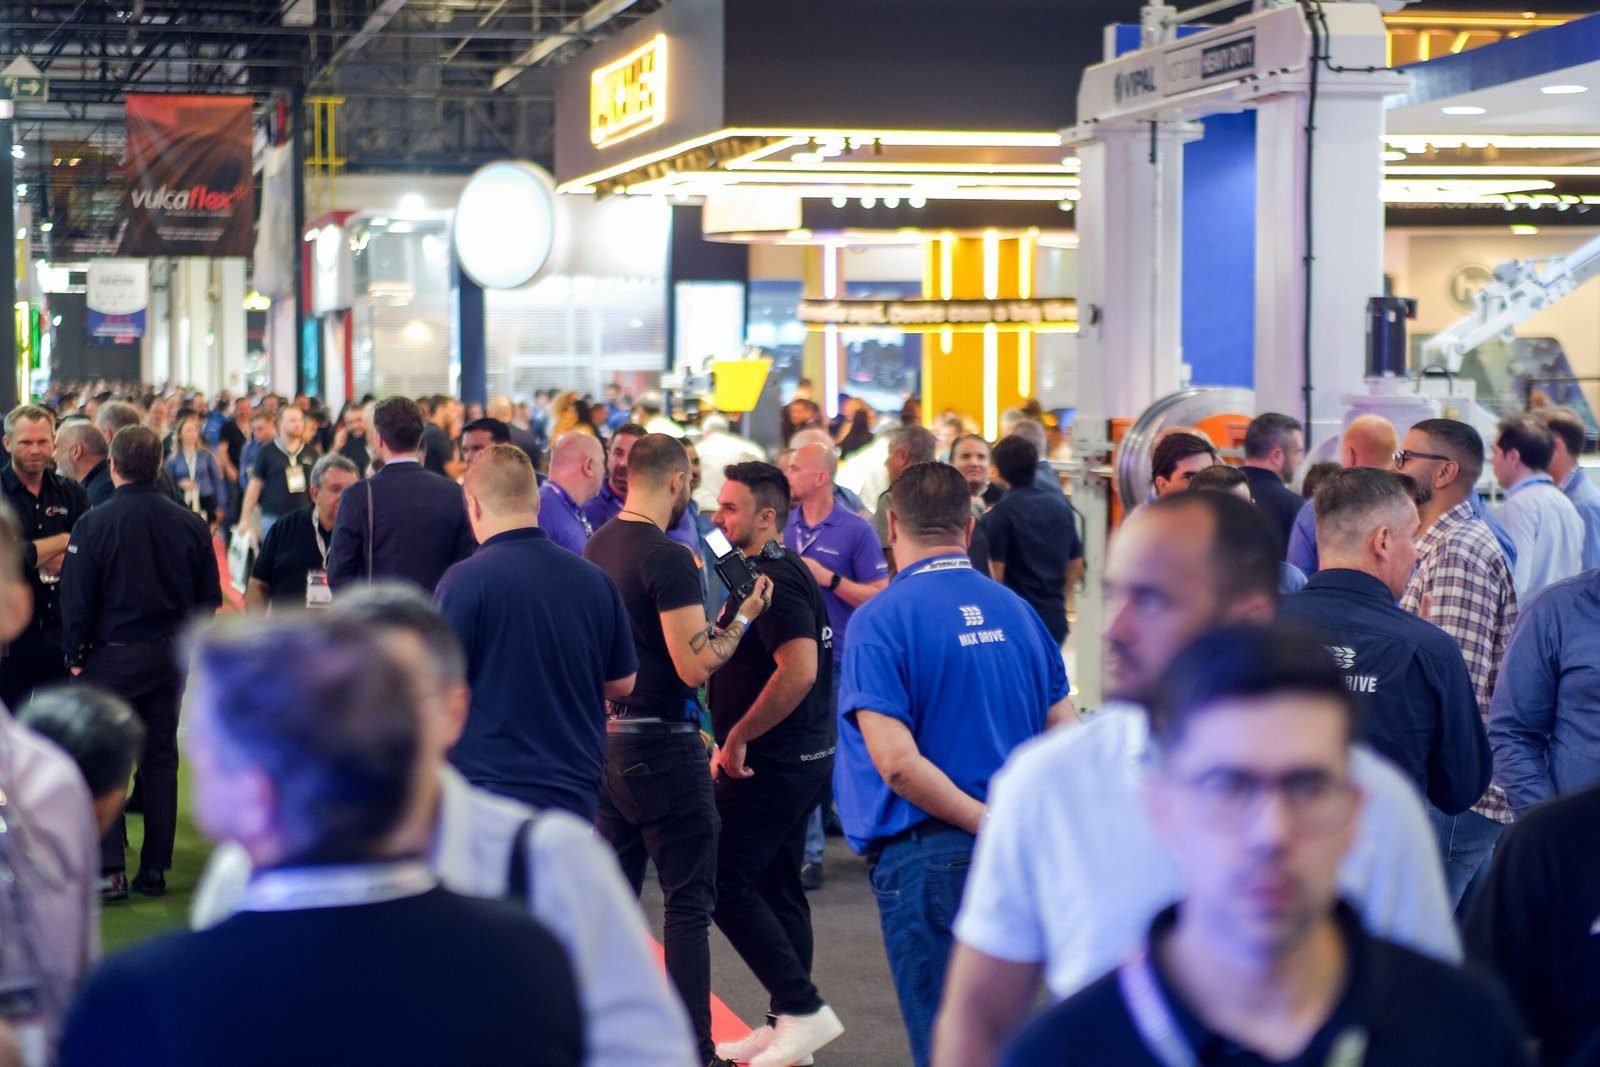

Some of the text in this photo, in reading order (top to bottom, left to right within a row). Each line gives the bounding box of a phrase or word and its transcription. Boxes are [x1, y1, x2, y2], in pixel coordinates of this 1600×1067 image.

[131, 183, 233, 211] vulcaflex
[958, 628, 1006, 647] MAX DRIVE
